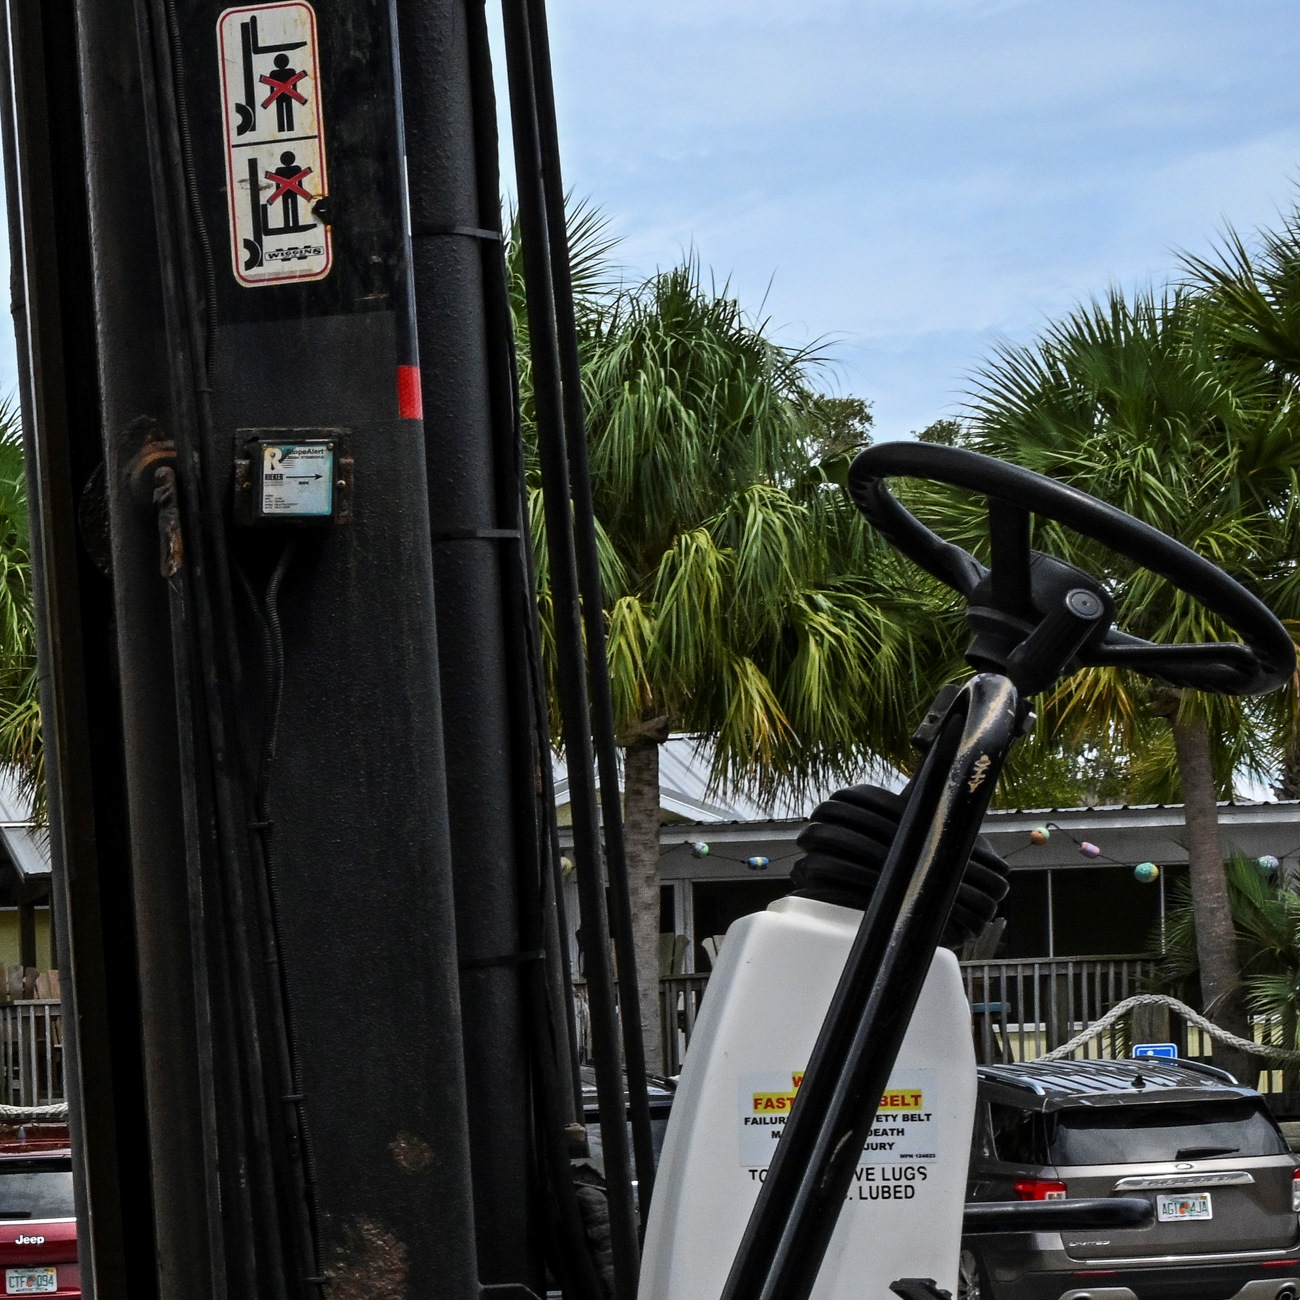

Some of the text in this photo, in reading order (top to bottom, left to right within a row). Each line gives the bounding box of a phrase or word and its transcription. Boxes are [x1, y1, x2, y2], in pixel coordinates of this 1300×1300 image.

[268, 248, 321, 258] WIGGINS
[878, 1094, 922, 1106] BELT
[744, 1117, 790, 1125] FAILUR
[902, 1113, 932, 1122] BELT
[881, 1166, 928, 1181] LUGS
[859, 1185, 915, 1200] LUBED
[15, 1234, 45, 1245] Jeep
